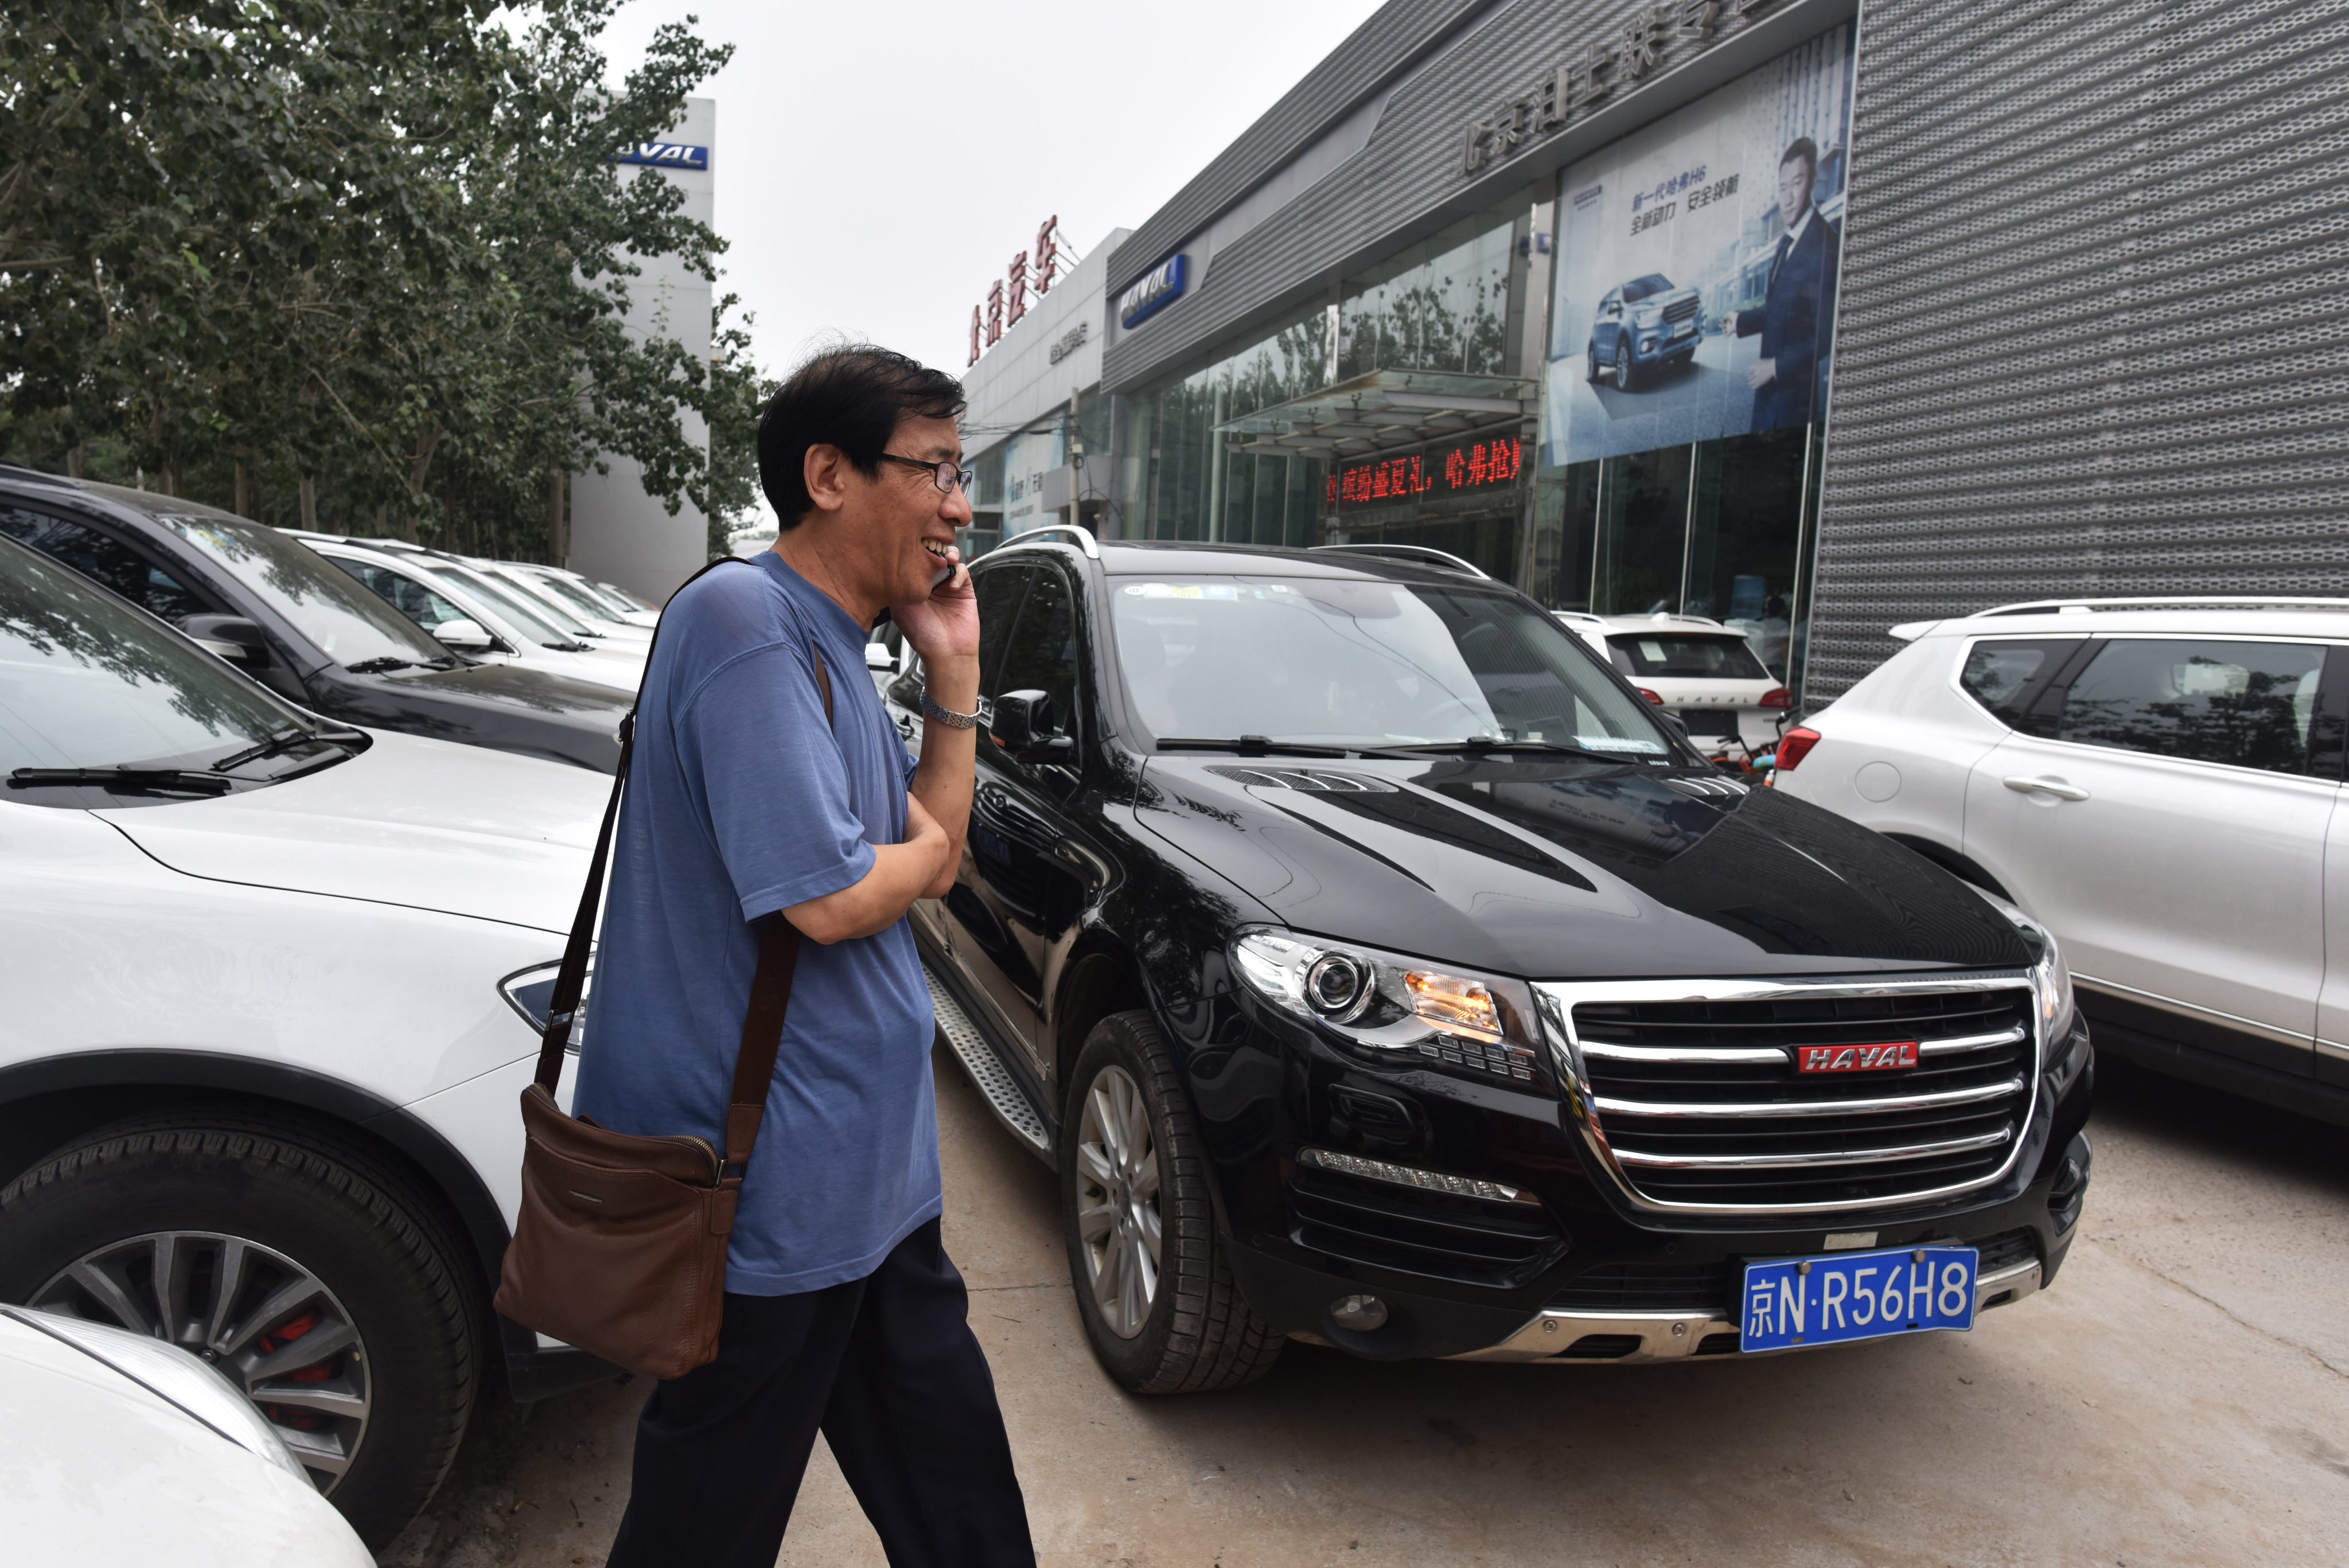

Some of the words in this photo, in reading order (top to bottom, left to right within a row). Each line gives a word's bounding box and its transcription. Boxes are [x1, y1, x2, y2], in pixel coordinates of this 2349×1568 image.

[1630, 202, 1677, 237] 全新动力
[1688, 173, 1740, 213] 安全领航
[1120, 263, 1175, 321] HAVAL
[1805, 1046, 1916, 1070] HAVAL
